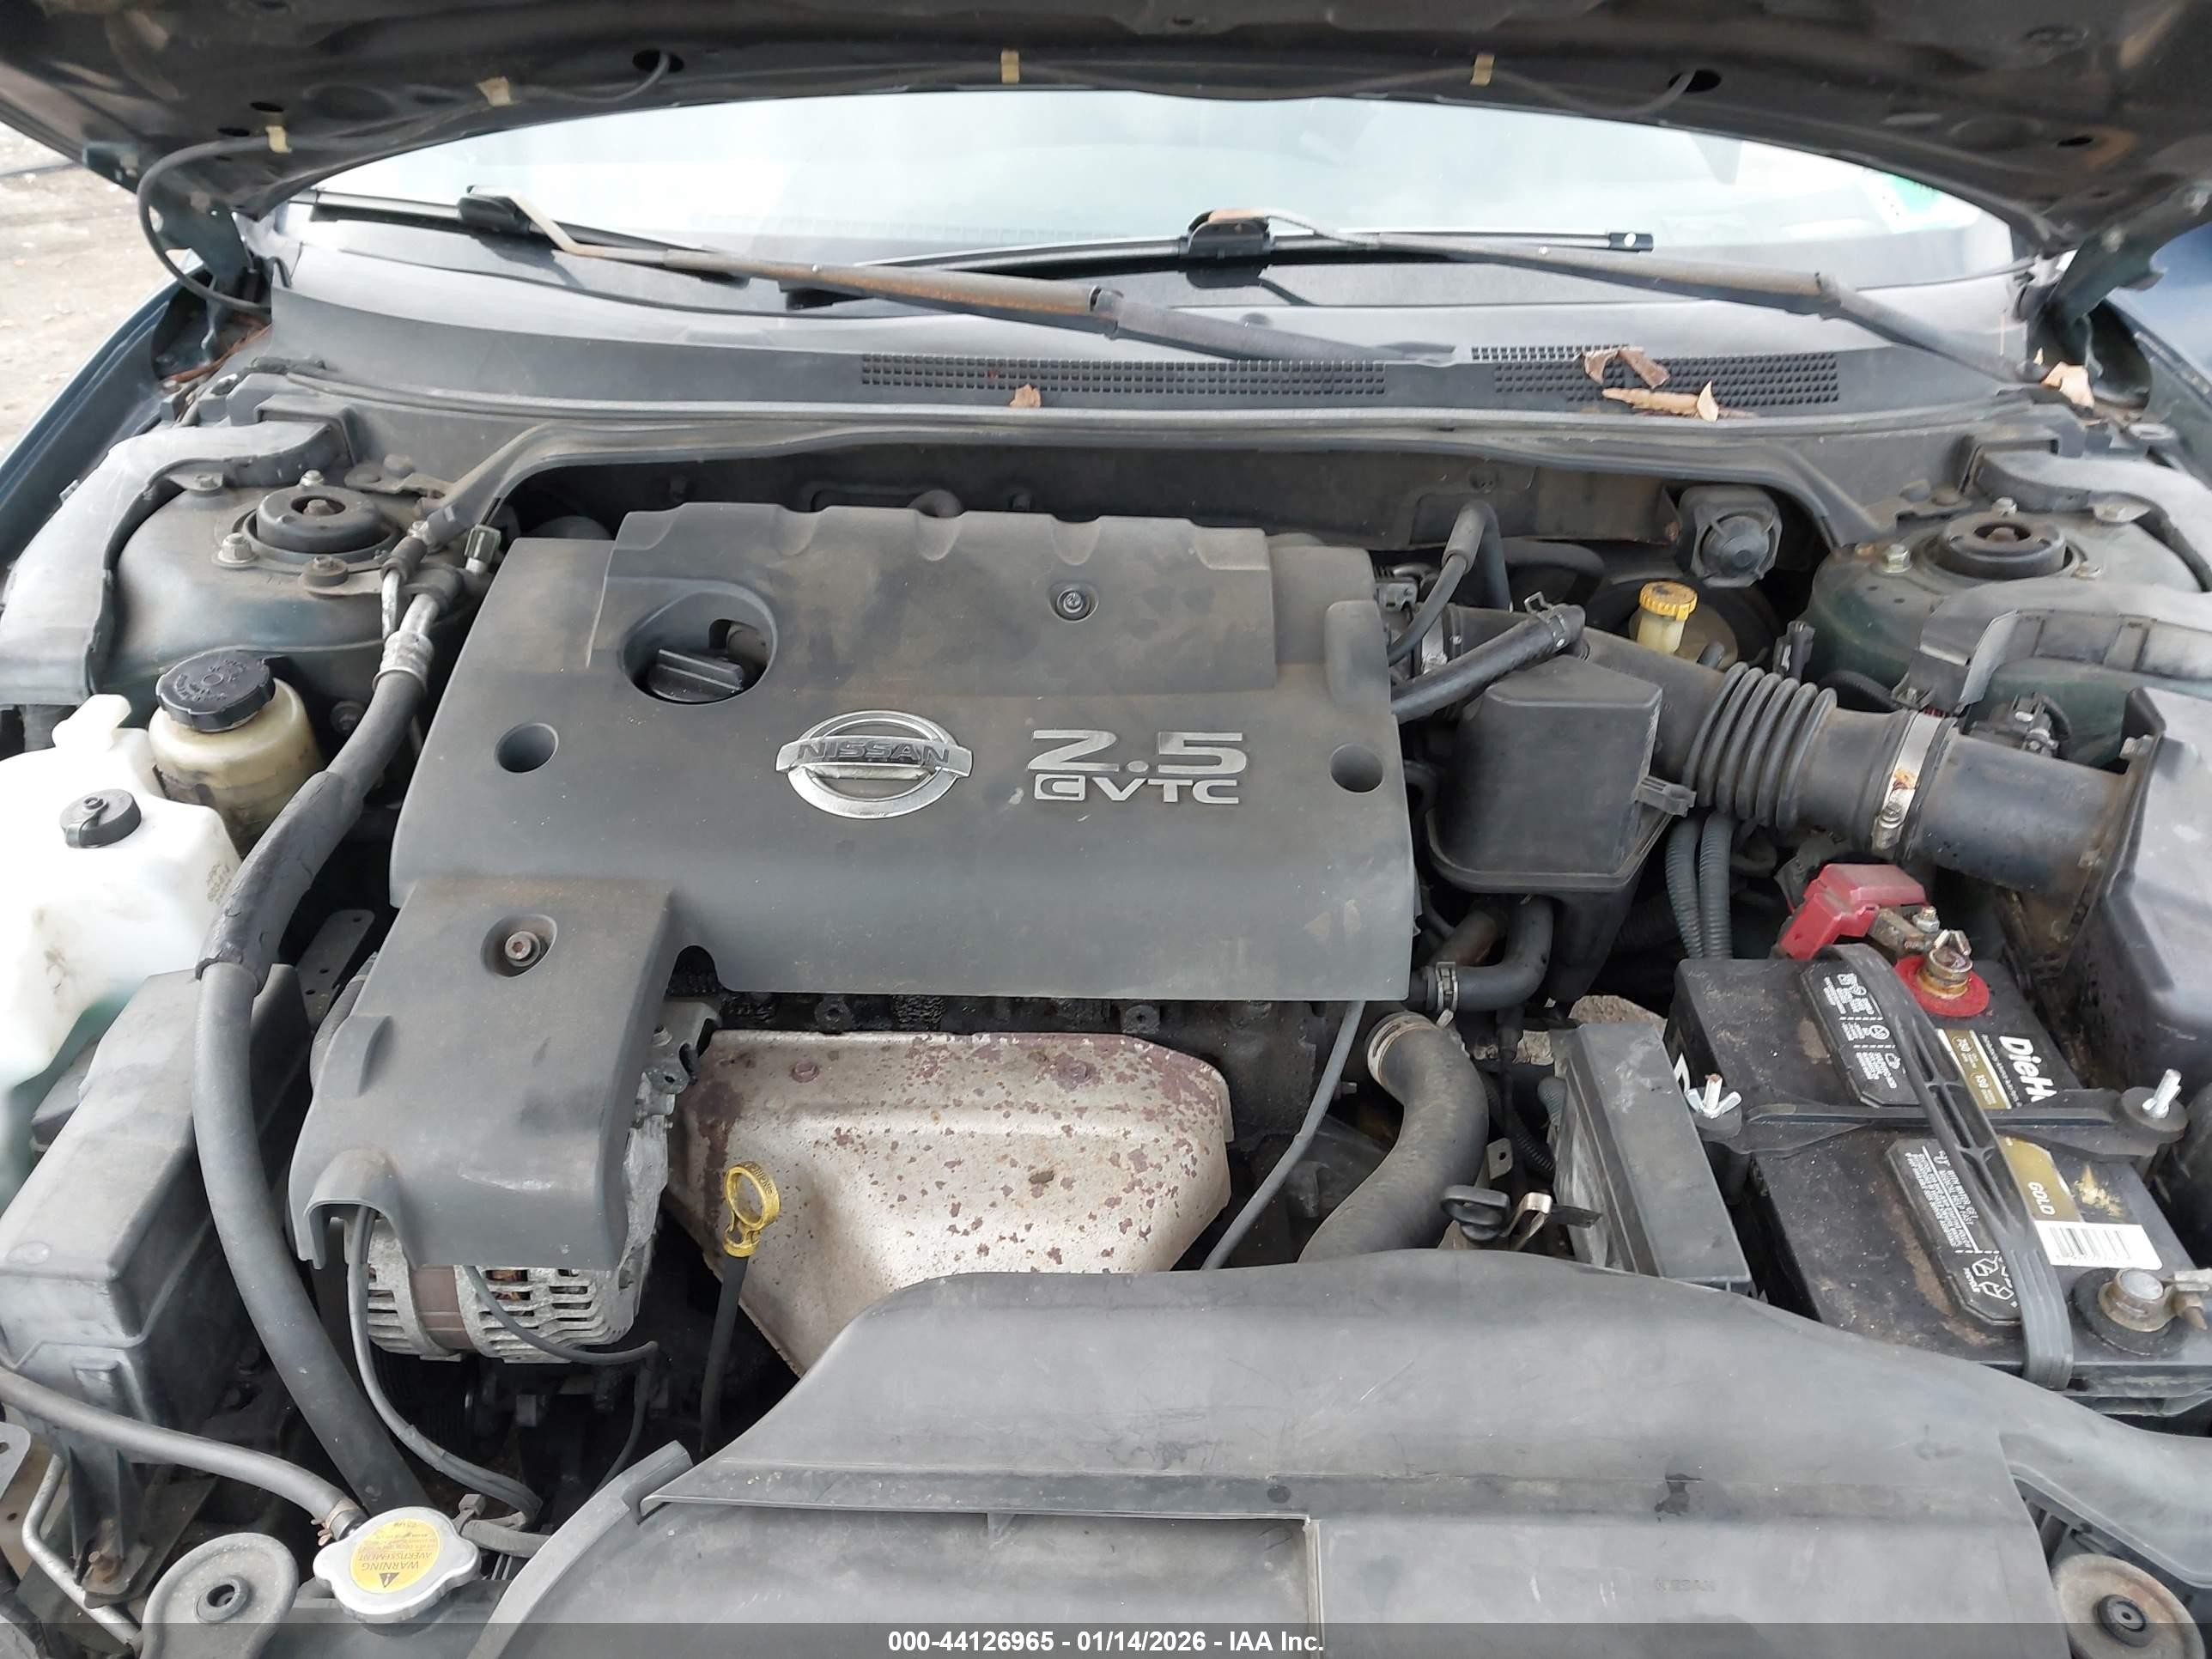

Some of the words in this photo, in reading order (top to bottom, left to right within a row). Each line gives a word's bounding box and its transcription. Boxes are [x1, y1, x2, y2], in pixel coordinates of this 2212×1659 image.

[796, 738, 950, 765] NISSAN
[1028, 729, 1248, 775] 2.5
[1999, 1036, 2057, 1103] DieH
[2027, 1181, 2057, 1216] GOLD
[362, 1562, 419, 1571] WARNING
